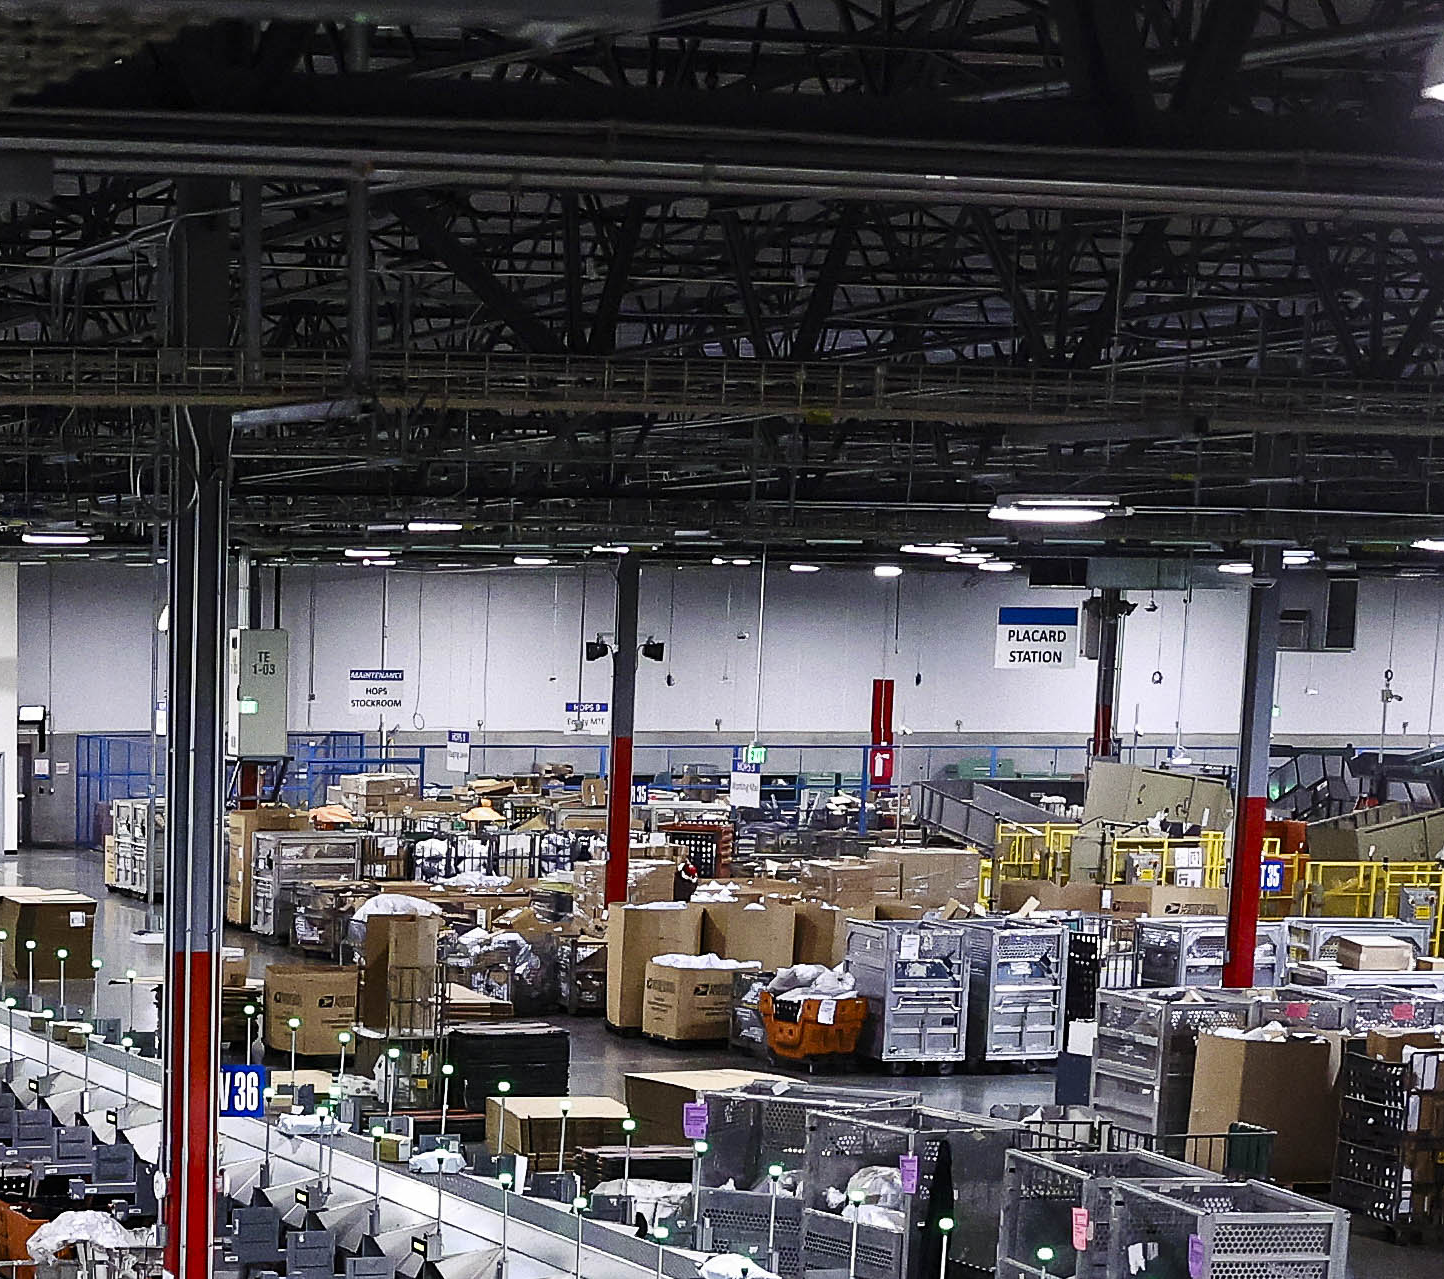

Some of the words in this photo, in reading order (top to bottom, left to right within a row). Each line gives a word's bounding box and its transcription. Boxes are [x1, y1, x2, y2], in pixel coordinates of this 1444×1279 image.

[1008, 630, 1067, 643] PLACARD
[258, 651, 270, 662] TE
[1009, 651, 1062, 663] STATION
[252, 664, 276, 675] 1-03
[351, 671, 402, 679] MAINTENANCE
[366, 687, 388, 695] HOPS
[351, 699, 402, 707] STOCKROOM
[1266, 864, 1280, 888] 35
[234, 1071, 259, 1111] 36
